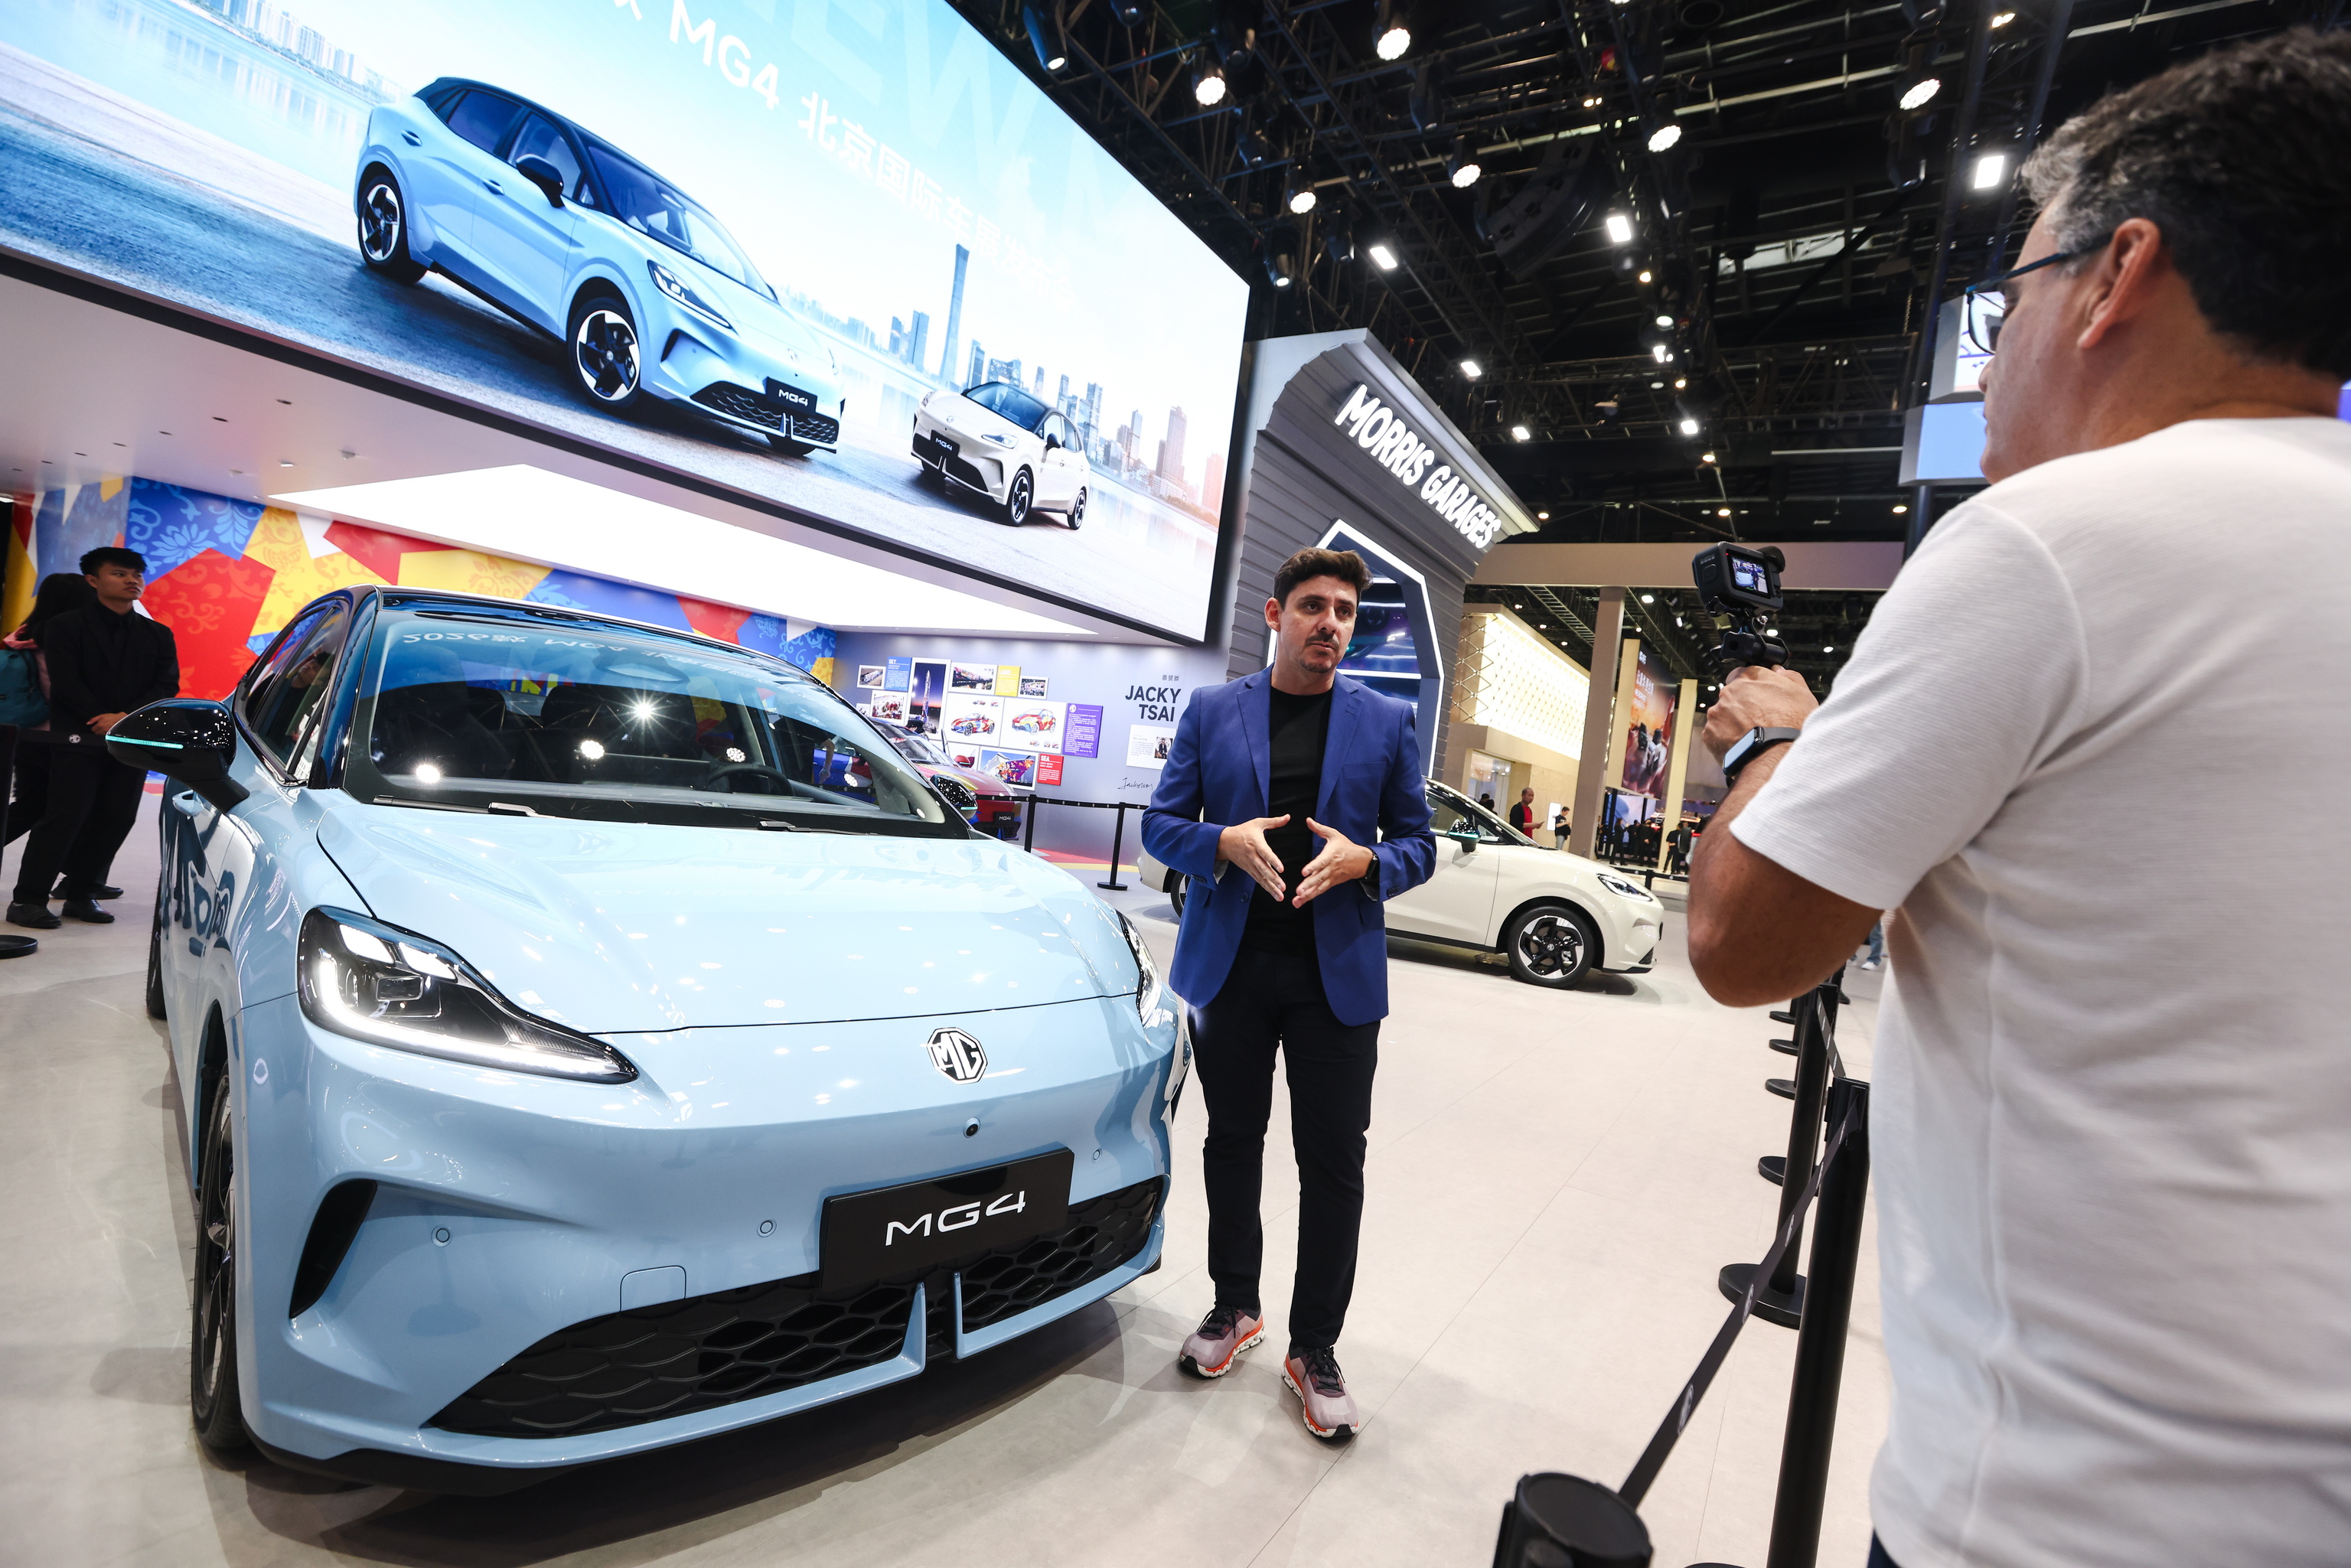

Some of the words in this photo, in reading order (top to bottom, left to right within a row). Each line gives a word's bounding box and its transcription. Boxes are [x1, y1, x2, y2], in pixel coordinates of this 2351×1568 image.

[669, 0, 779, 110] MG4
[797, 92, 1076, 311] 北京国际车展发布会
[778, 389, 808, 406] MG4
[935, 438, 953, 451] MG4
[1334, 383, 1435, 486] MORRIS
[1420, 465, 1502, 549] GARAGES
[1125, 685, 1182, 703] JACKY
[1139, 704, 1175, 722] TSAI
[931, 1031, 983, 1081] MG
[885, 1190, 1026, 1247] MG4
